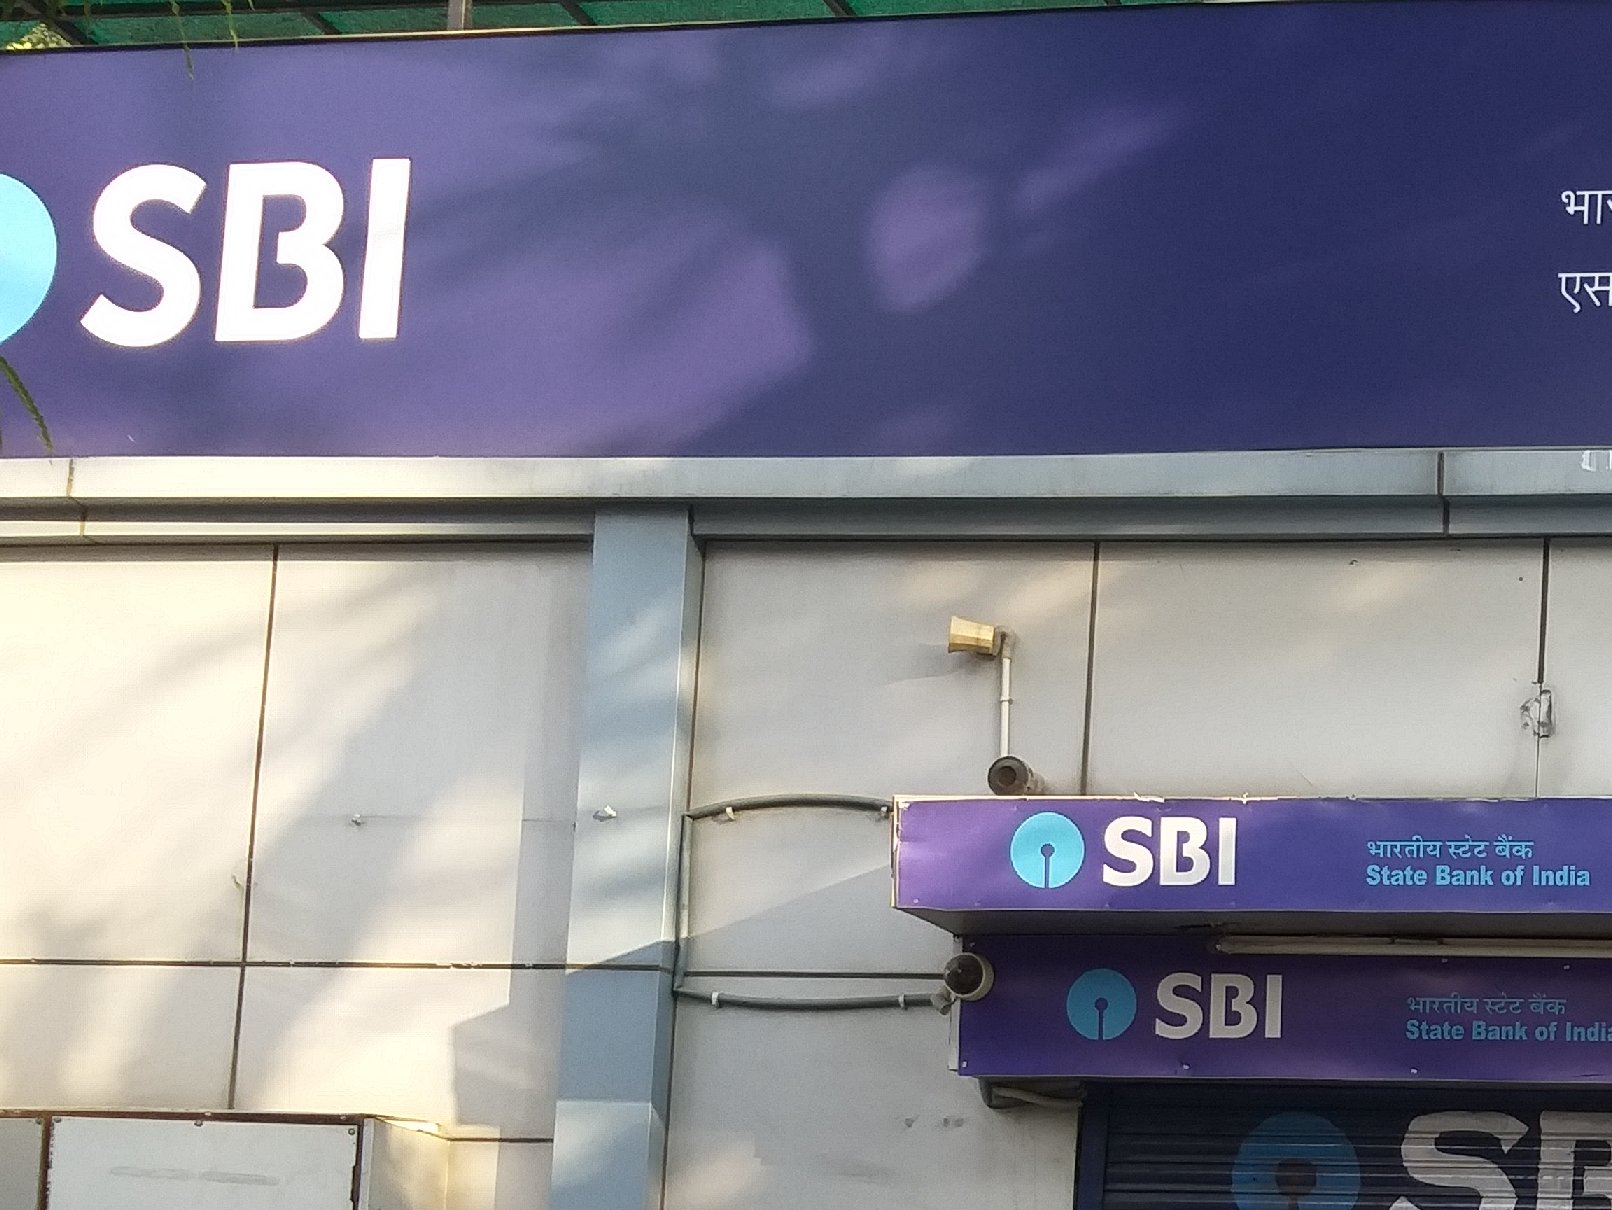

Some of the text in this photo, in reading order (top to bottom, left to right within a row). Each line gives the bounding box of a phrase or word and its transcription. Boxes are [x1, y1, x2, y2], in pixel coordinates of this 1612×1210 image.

[80, 158, 411, 347] SBI
[1103, 816, 1237, 887] SBI
[1366, 834, 1534, 860] भारतीय स्टेट बैंक
[1366, 865, 1590, 887] State Bank of India
[1155, 972, 1283, 1039] SBI
[1407, 992, 1568, 1015] भारतीय स्टेट बैंक
[1406, 1019, 1465, 1040] State
[1472, 1020, 1528, 1041] Bank
[1535, 1021, 1557, 1041] of
